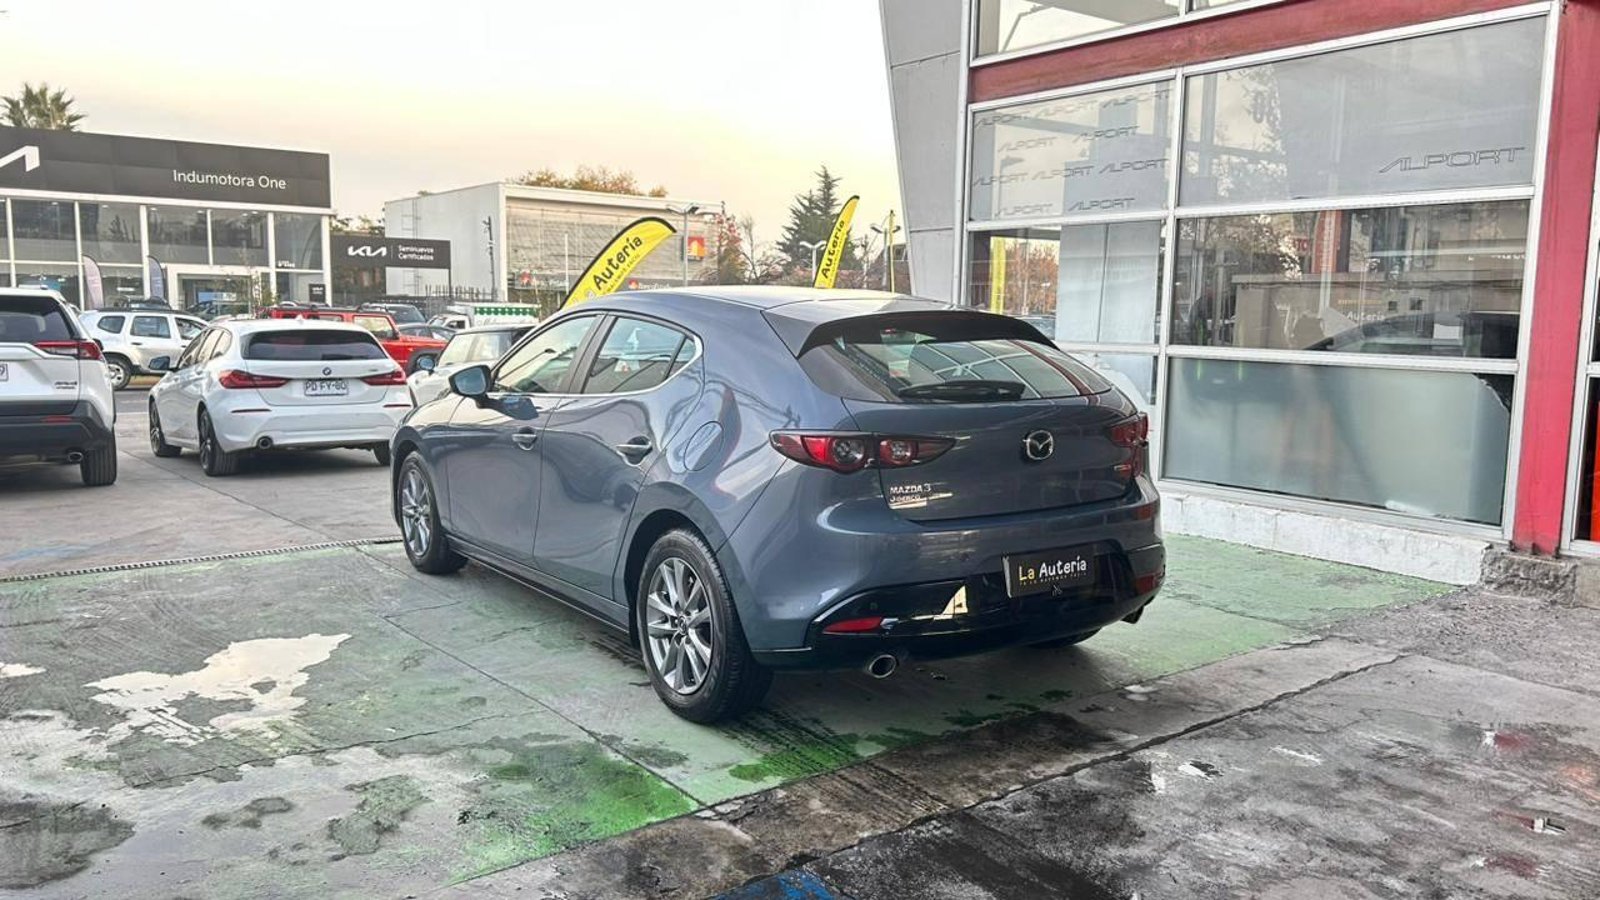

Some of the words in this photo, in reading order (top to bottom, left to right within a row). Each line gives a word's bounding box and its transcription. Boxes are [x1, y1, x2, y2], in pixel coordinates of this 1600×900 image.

[1379, 147, 1525, 174] ALPORT
[173, 169, 255, 187] Indumotora
[258, 175, 287, 190] One
[347, 245, 387, 257] KIA
[593, 236, 642, 290] Autería
[1019, 566, 1035, 581] La
[1039, 555, 1087, 578] Autería
